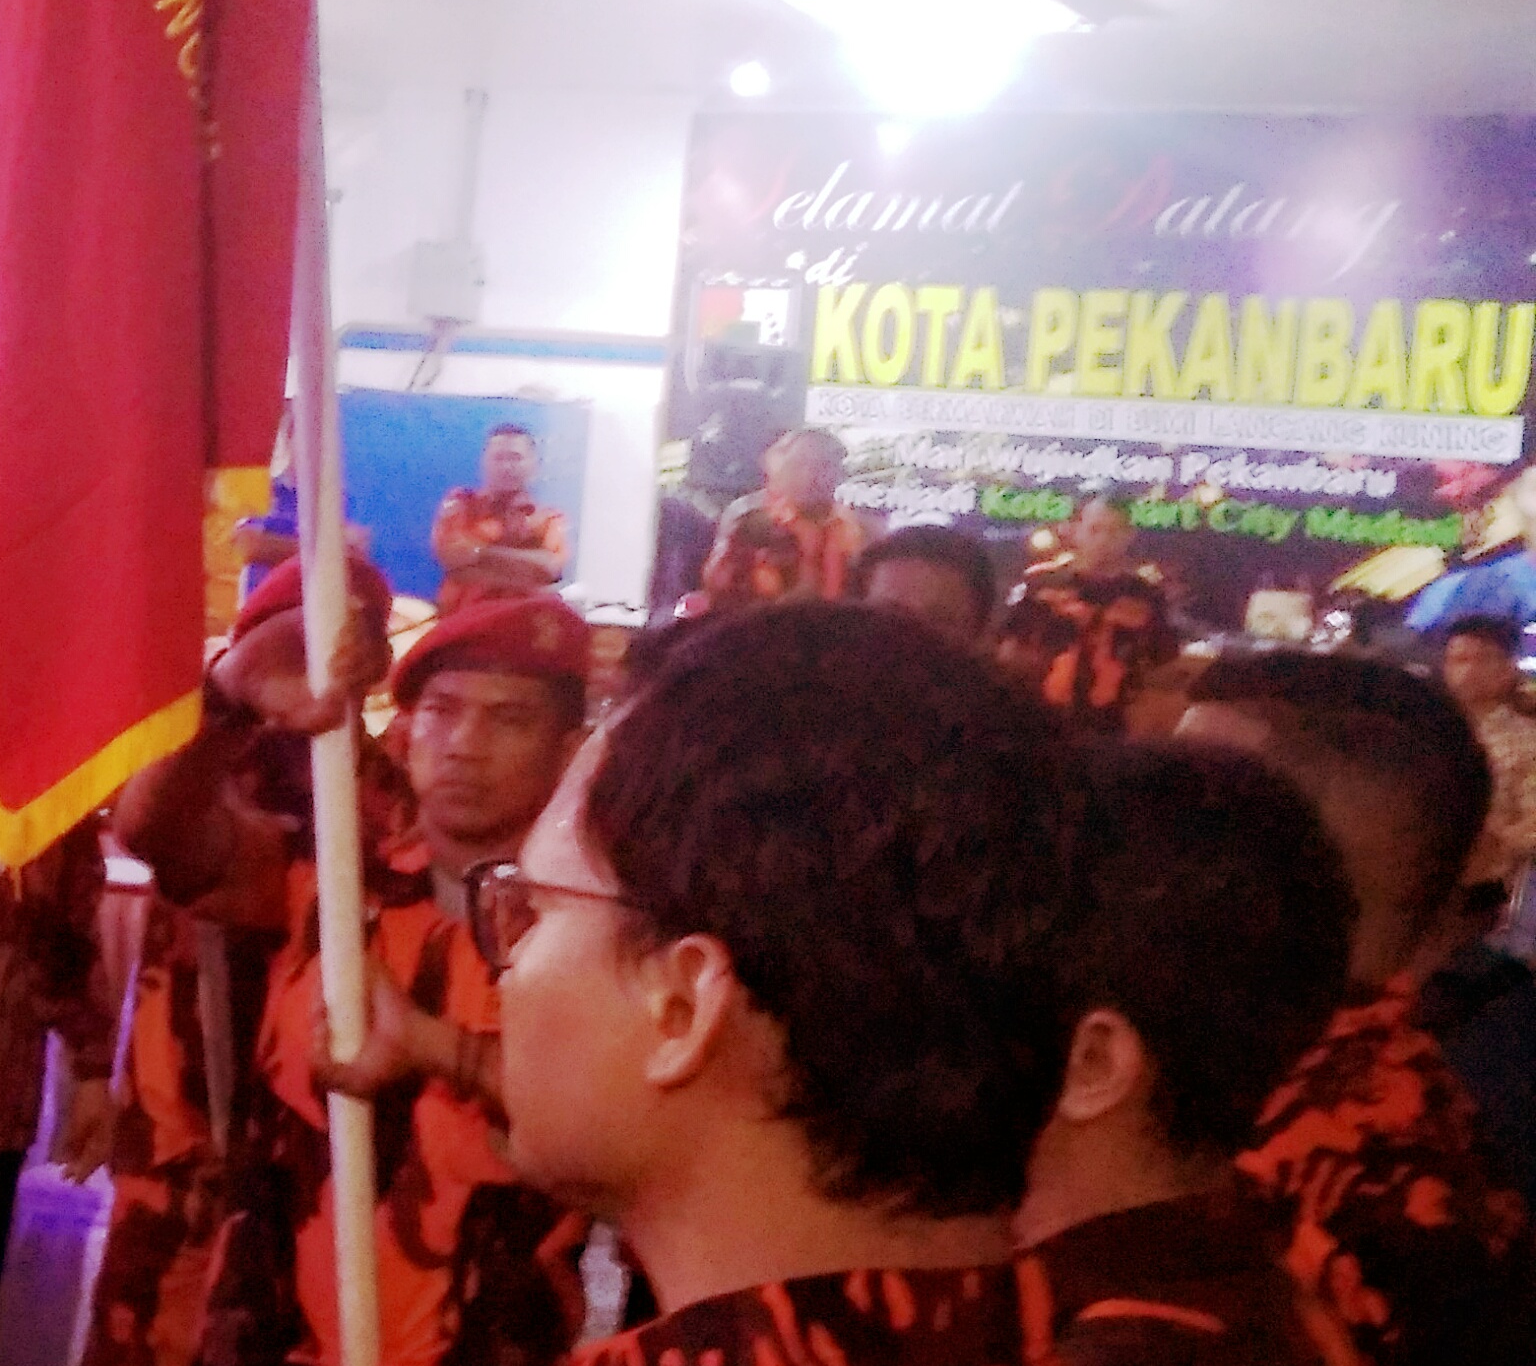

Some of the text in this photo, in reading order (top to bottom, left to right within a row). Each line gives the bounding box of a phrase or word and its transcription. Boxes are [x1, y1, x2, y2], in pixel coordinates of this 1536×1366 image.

[722, 153, 1026, 232] elamat
[810, 283, 1535, 416] KOTA PEKANBARU
